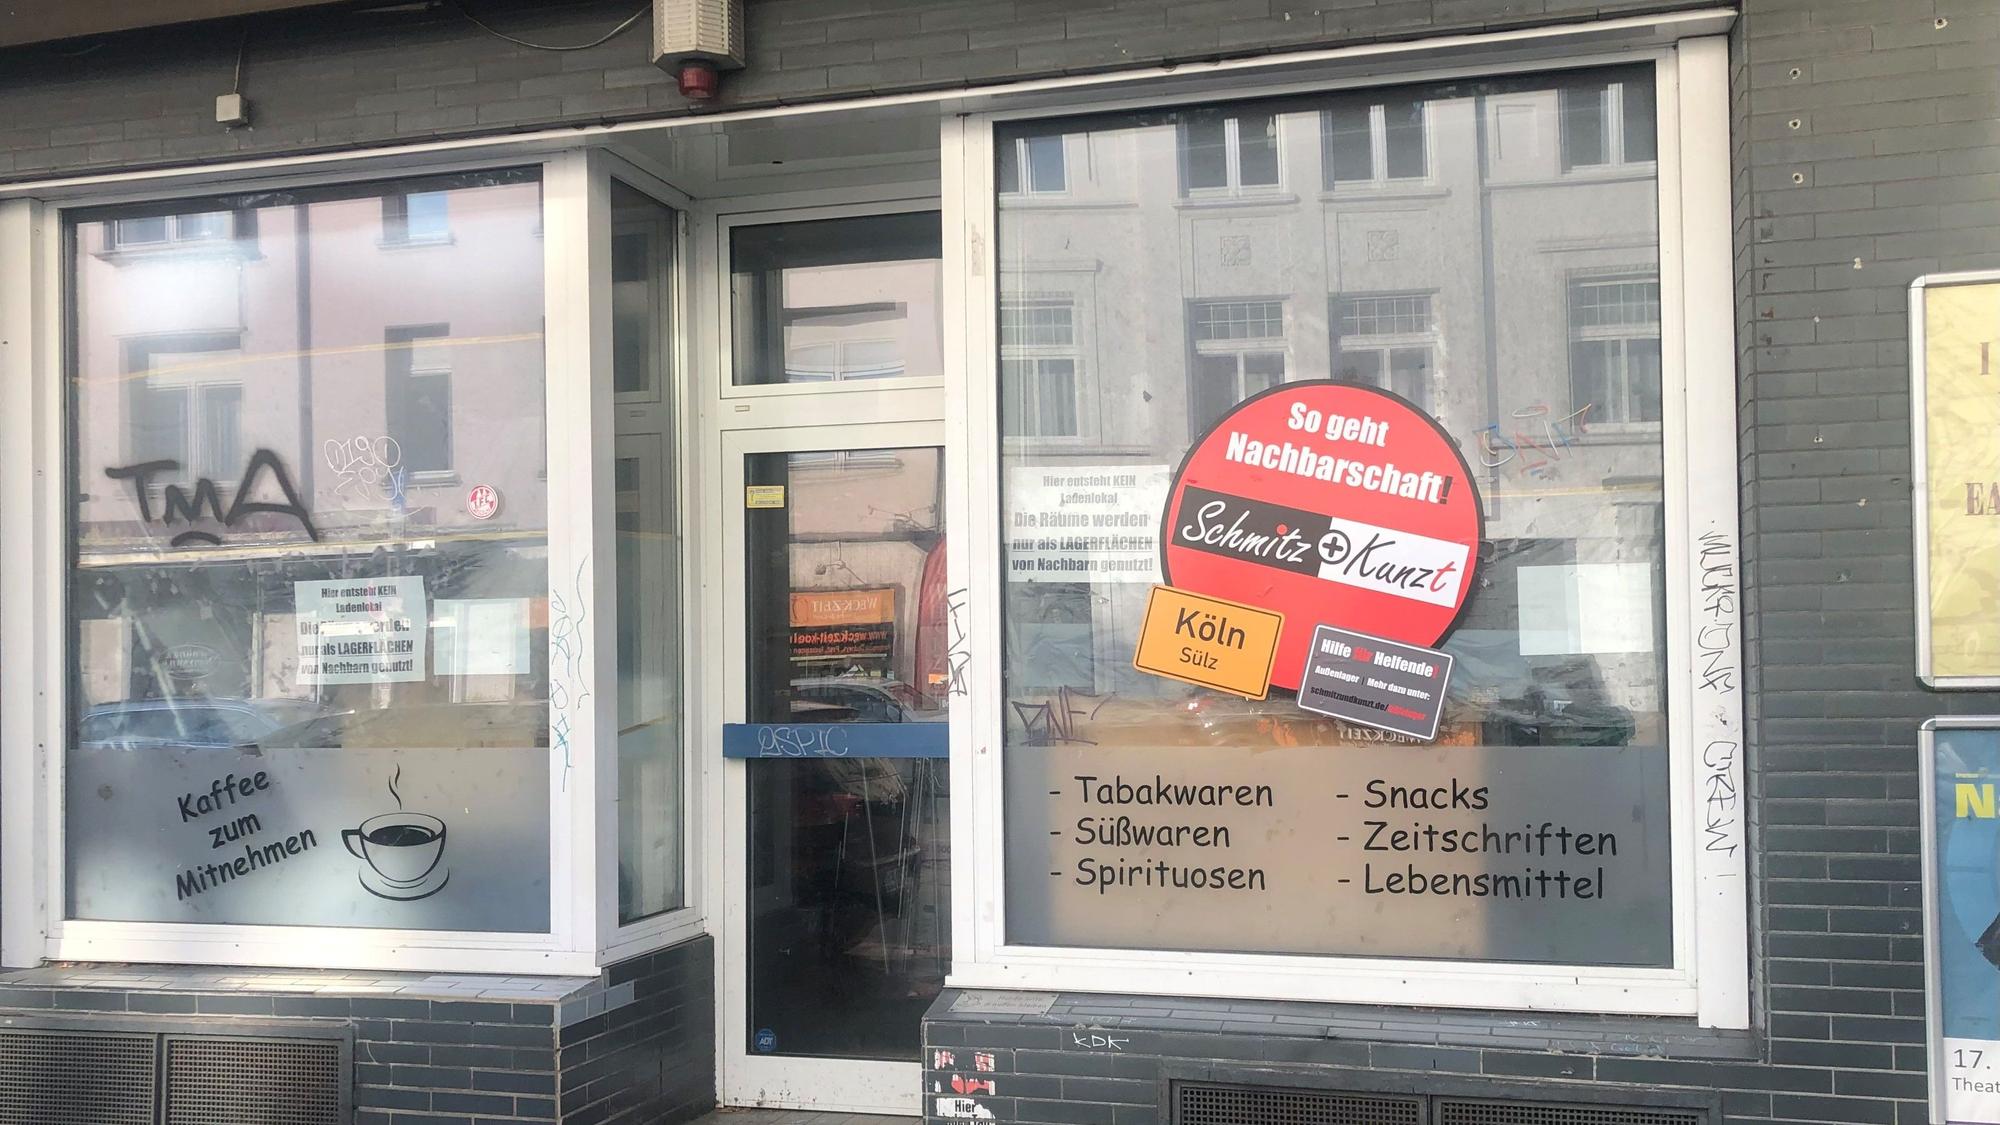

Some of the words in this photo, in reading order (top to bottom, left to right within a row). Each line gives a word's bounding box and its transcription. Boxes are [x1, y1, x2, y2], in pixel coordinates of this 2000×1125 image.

[1288, 401, 1322, 433] So
[1325, 414, 1389, 447] geht
[1043, 475, 1065, 487] Hier
[1067, 474, 1110, 487] entsteht
[1113, 474, 1136, 487] KEIN
[1225, 431, 1453, 505] Nachbarschaft!
[1061, 492, 1118, 504] Ladenlokal
[1014, 511, 1036, 527] Die
[1039, 511, 1089, 527] Räume
[1092, 511, 1148, 527] werden
[1013, 537, 1035, 550] nur
[1037, 536, 1057, 550] als
[1059, 534, 1152, 550] LAGERFLÄCHEN
[1181, 500, 1312, 563] Schmitz
[1343, 532, 1457, 593] Kunzt
[1012, 559, 1034, 571] von
[1037, 557, 1098, 571] Nachbarn
[1100, 557, 1153, 573] genutzt!
[321, 588, 338, 598] Hier
[341, 586, 377, 598] entsteht
[377, 585, 397, 597] KEIN
[300, 621, 319, 635] Die
[1174, 607, 1246, 650] Köln
[321, 661, 370, 675] Nachbarn
[1179, 647, 1218, 671] Sülz
[1321, 638, 1352, 658] Hilfe
[1373, 651, 1440, 679] Helfende!
[1315, 665, 1360, 684] Außenlager
[1367, 677, 1388, 691] Mehr
[1388, 683, 1406, 695] dazu
[1407, 688, 1431, 701] unter:
[178, 771, 269, 823] Kaffee
[1074, 774, 1273, 807] Tabakwaren
[1364, 778, 1489, 810] Snacks
[208, 813, 261, 849] zum
[1075, 816, 1230, 848] Süßwaren
[1363, 820, 1617, 857] Zeitschriften
[176, 829, 317, 901] Mitnehmen
[1075, 857, 1266, 895] Spirituosen
[1364, 863, 1603, 900] Lebensmittel
[1073, 1032, 1130, 1050] KDK
[1953, 1048, 1991, 1070] 17.
[954, 1099, 976, 1113] Hier
